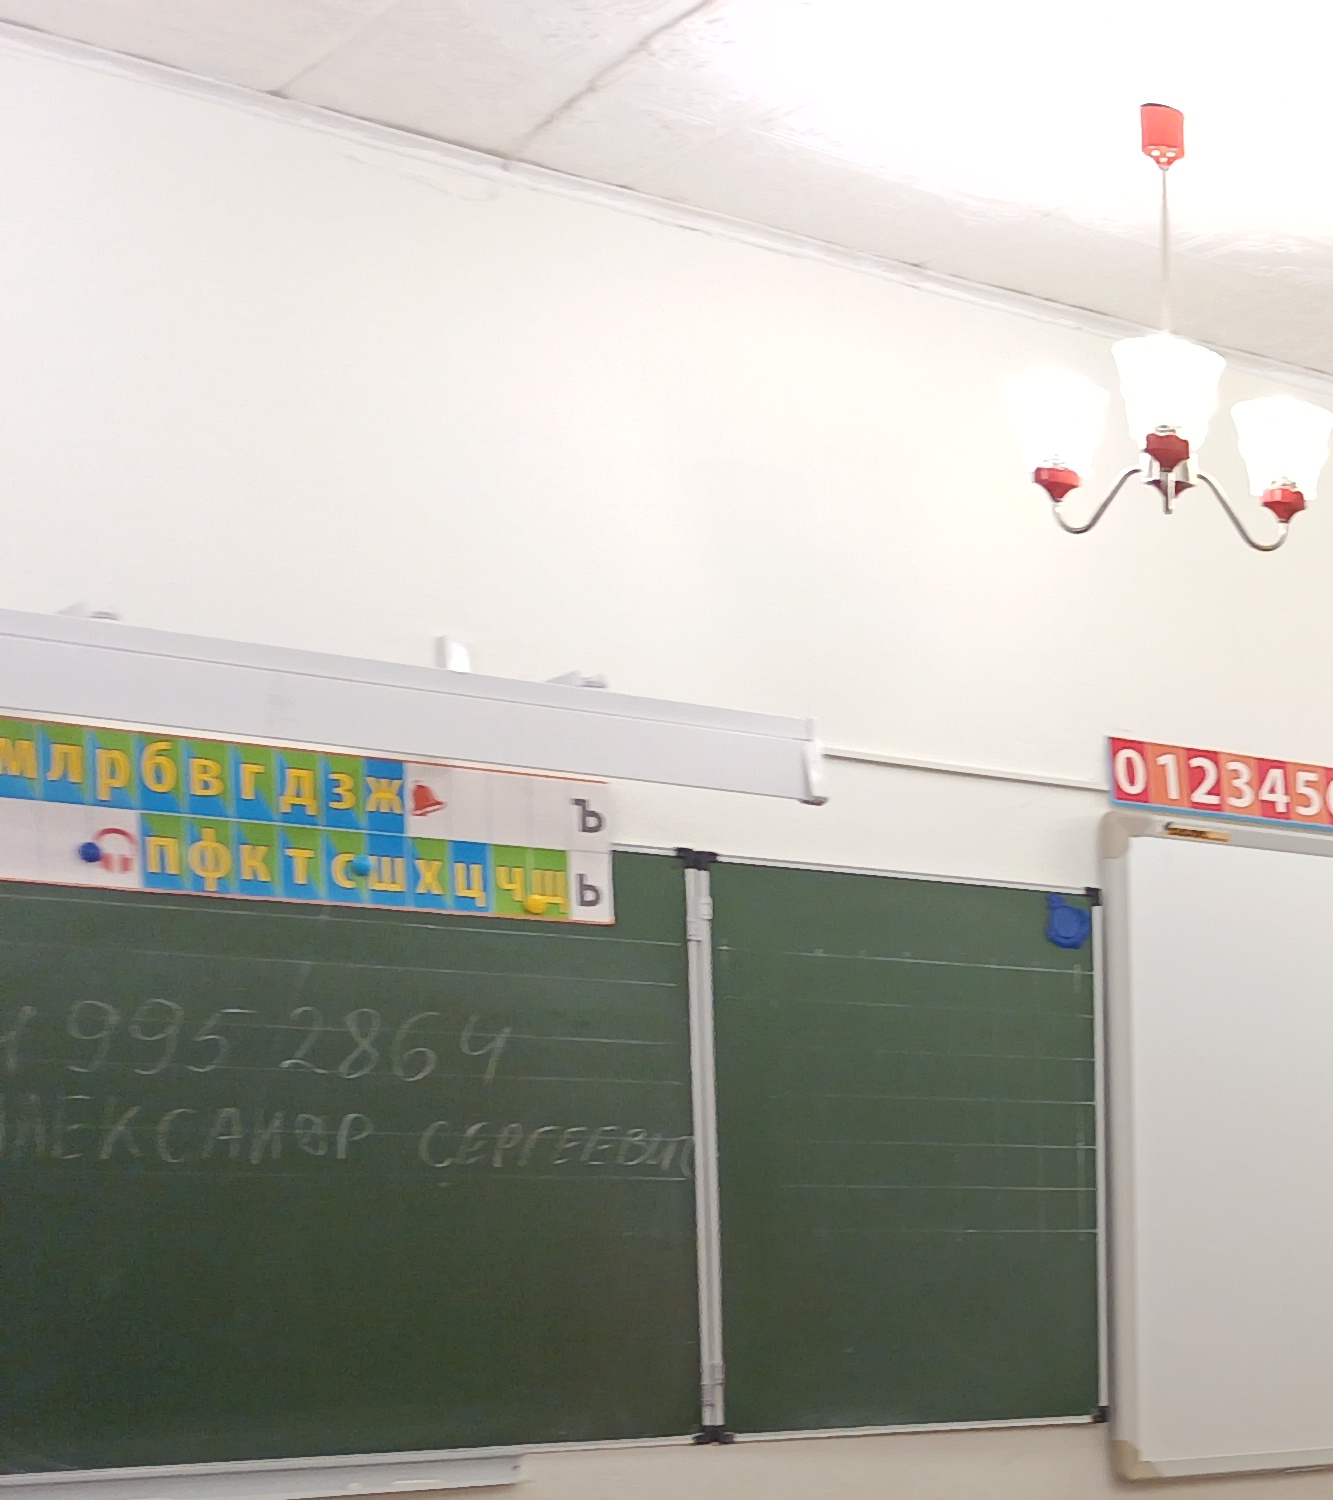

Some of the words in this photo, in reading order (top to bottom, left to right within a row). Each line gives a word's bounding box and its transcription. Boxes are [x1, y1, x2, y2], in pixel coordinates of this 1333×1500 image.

[47, 743, 84, 783] л
[96, 748, 130, 801] р
[142, 741, 177, 793] б
[189, 758, 224, 796] в
[240, 762, 266, 800] г
[279, 768, 318, 816] д
[328, 773, 356, 810] з
[365, 776, 404, 815] ж
[1115, 749, 1147, 794] 0
[1156, 754, 1180, 800] 1
[1190, 758, 1221, 805] 2
[1226, 762, 1256, 808] 3
[1259, 769, 1290, 813] 4
[1296, 771, 1321, 816] 5
[145, 836, 180, 875] п
[188, 827, 231, 892] ф
[240, 844, 272, 882] к
[285, 848, 315, 885] т
[368, 855, 406, 893] ш
[415, 858, 443, 895] х
[454, 862, 487, 908] ц
[496, 866, 525, 902] ч
[65, 998, 259, 1075] 995
[280, 1006, 513, 1084] 2864
